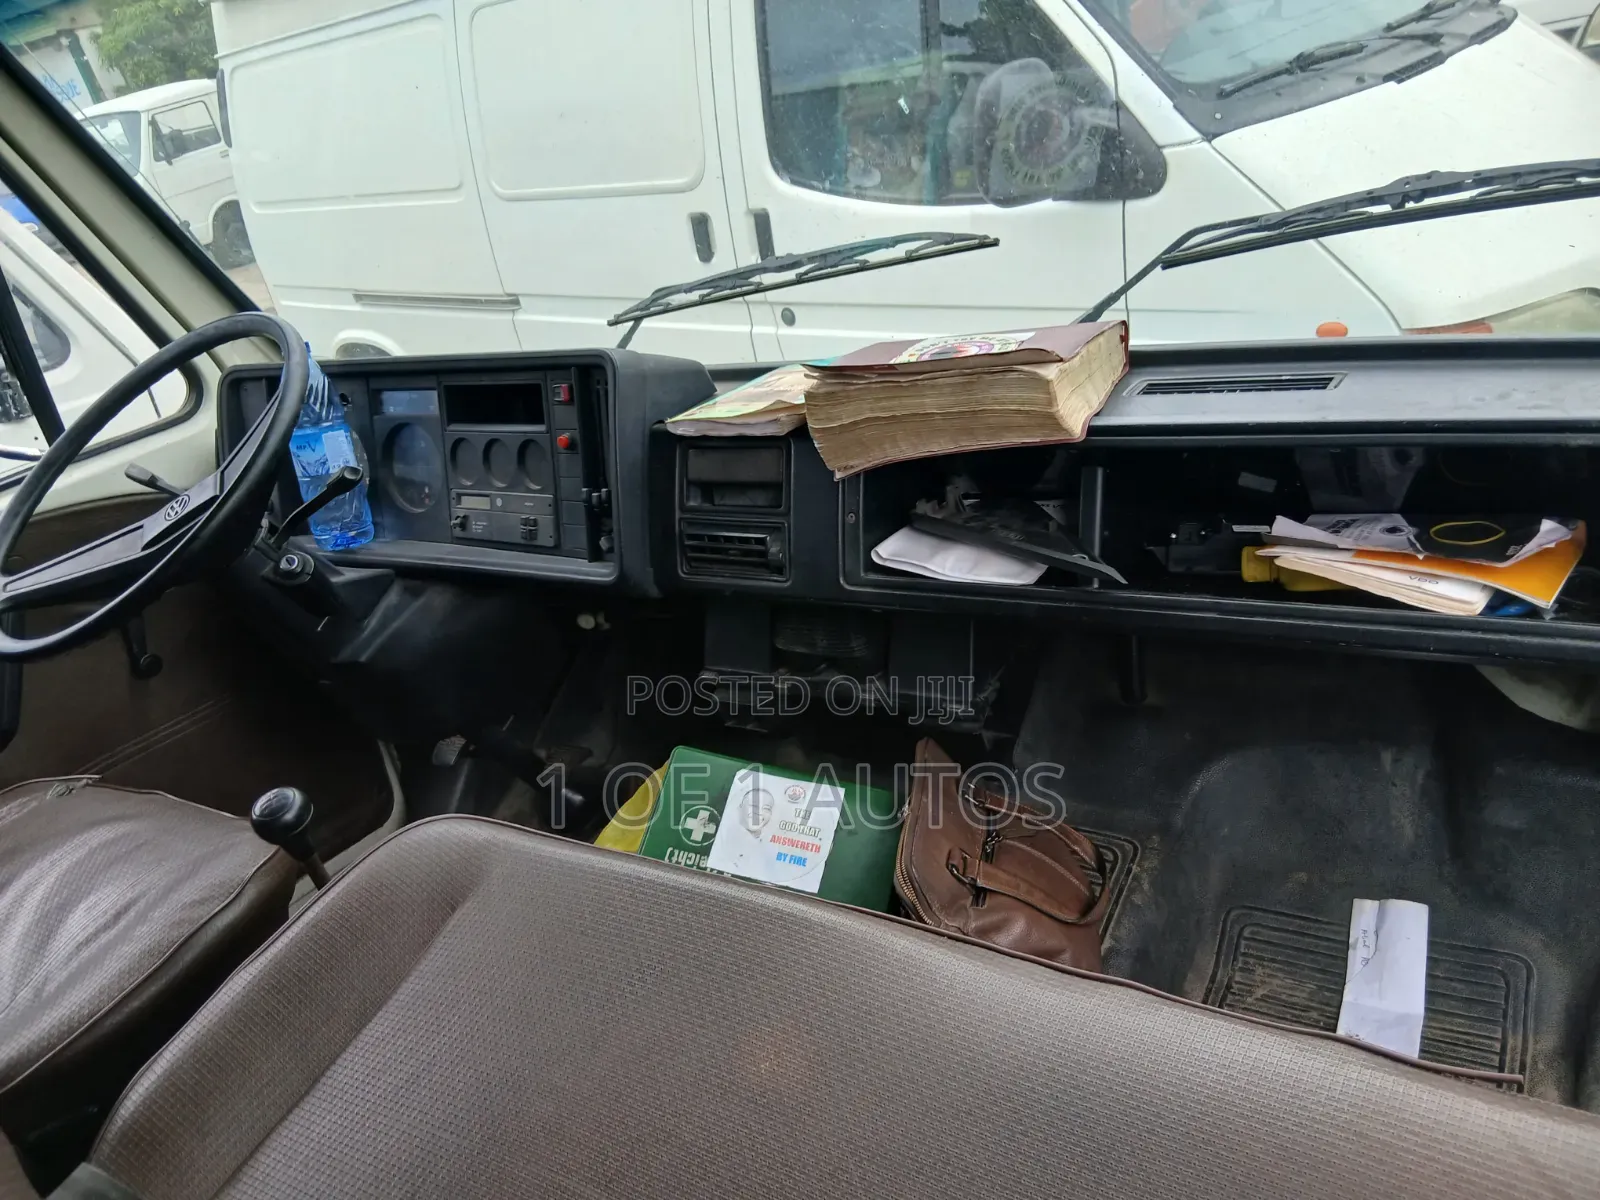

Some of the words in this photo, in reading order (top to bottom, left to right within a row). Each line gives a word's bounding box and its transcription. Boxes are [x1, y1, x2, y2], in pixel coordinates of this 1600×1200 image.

[1409, 575, 1439, 585] VDO
[795, 807, 811, 820] THE
[779, 819, 799, 833] GOD
[799, 823, 821, 838] THAT
[770, 834, 821, 854] ANSWERETH
[776, 851, 789, 864] BY
[789, 854, 808, 867] FIRE
